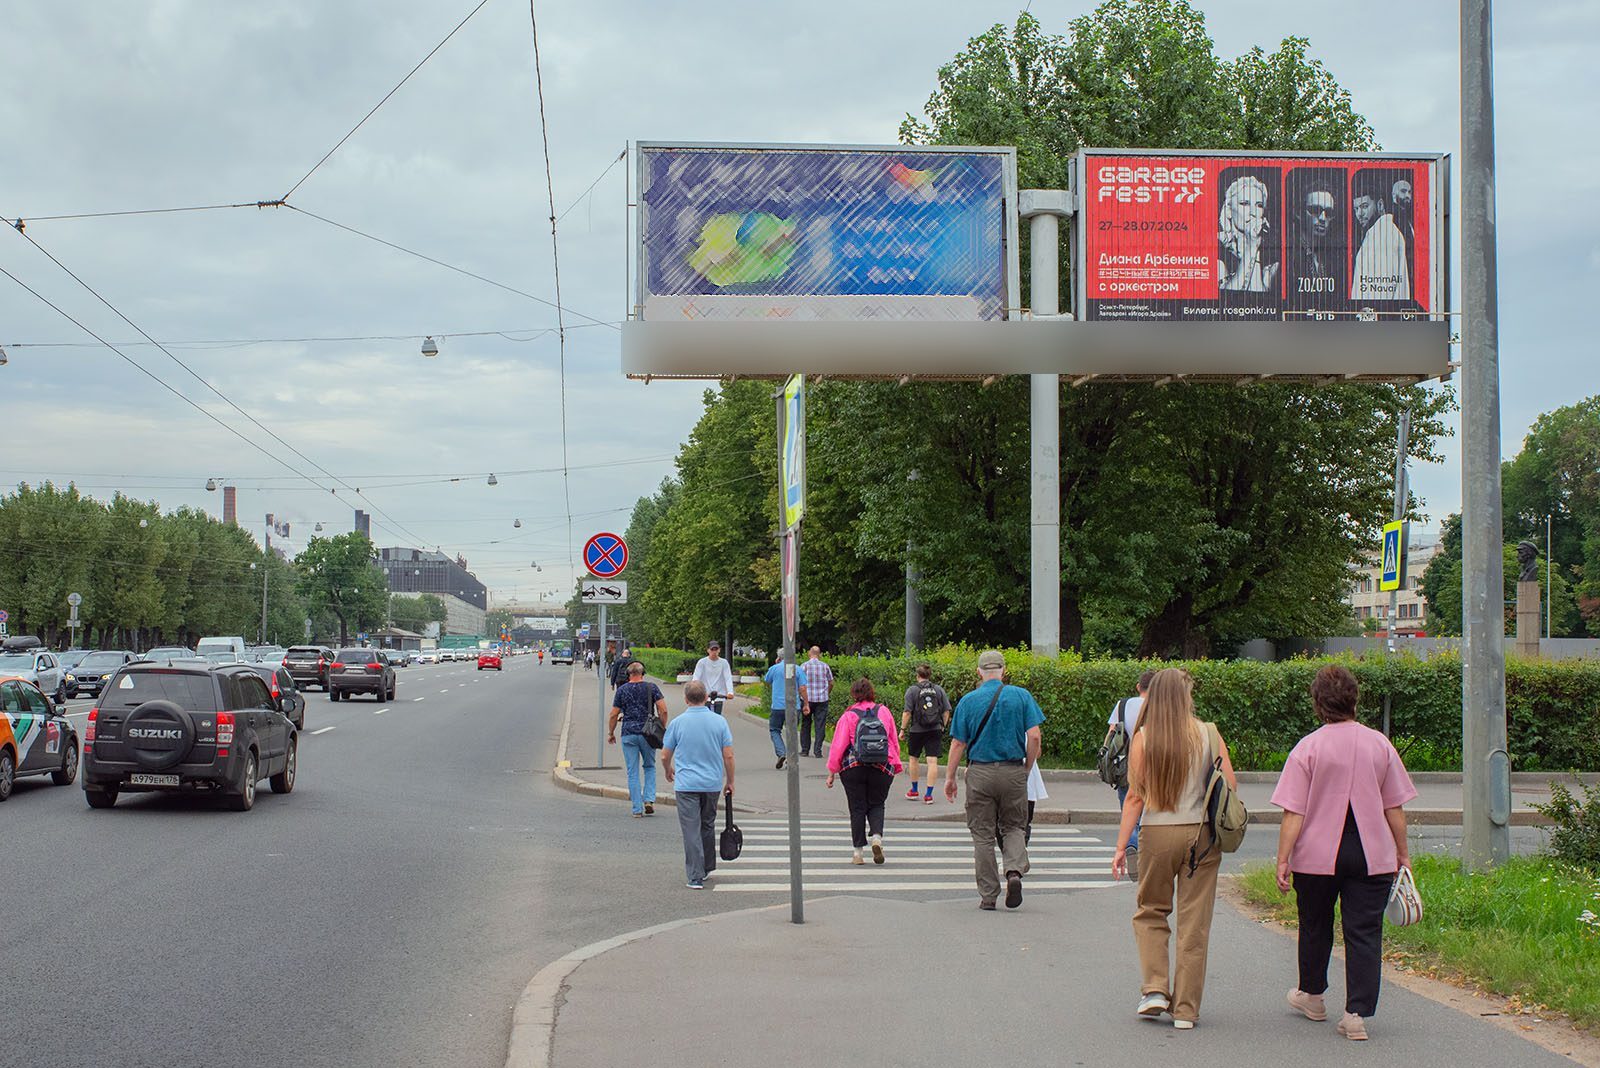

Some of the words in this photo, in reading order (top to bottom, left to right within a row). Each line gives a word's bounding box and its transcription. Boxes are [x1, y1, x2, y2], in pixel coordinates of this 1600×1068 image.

[1099, 253, 1141, 266] Диана
[1144, 253, 1209, 267] Арбенина
[1298, 277, 1335, 292] ZOLOTO
[1359, 275, 1403, 284] HammAli
[1099, 283, 1107, 291] с
[1109, 282, 1179, 294] оркестром
[1360, 284, 1368, 292] &
[1370, 284, 1397, 293] Navai
[1223, 305, 1276, 316] rosgonki.ru
[129, 728, 182, 739] SUZUKI
